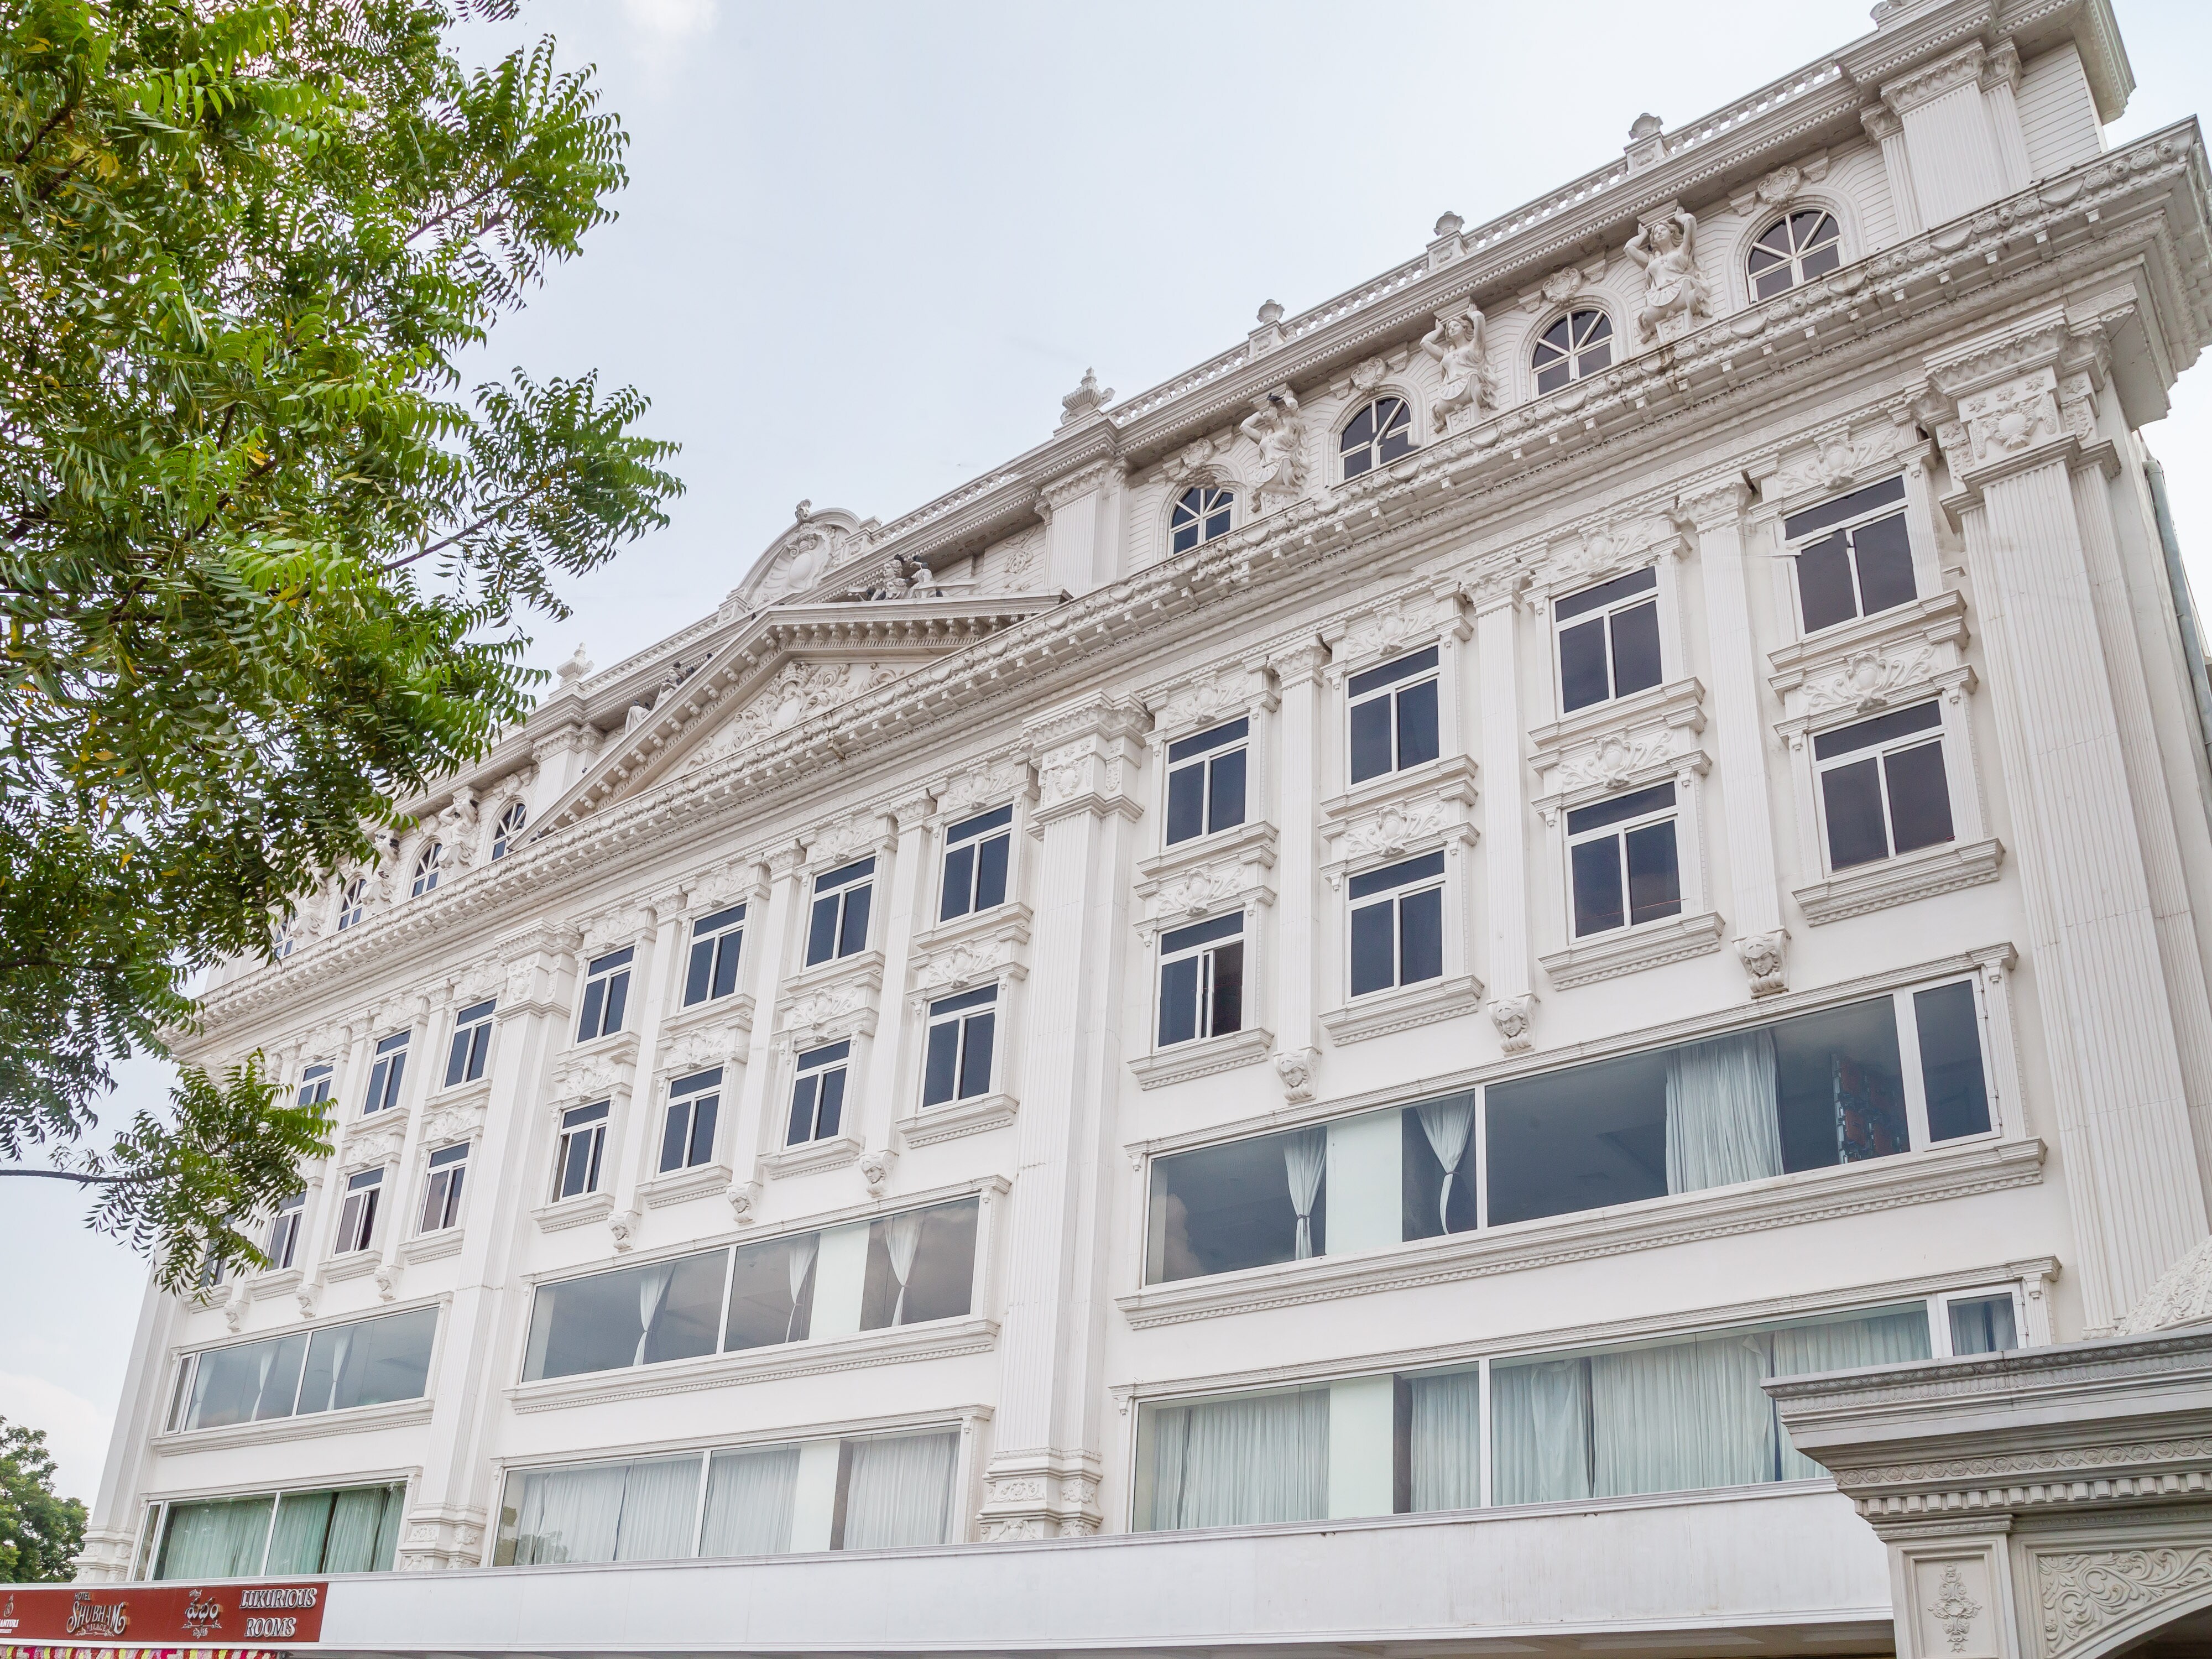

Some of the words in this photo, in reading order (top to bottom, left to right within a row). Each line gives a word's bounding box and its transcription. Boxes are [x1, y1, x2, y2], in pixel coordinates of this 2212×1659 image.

[74, 1592, 91, 1600] HOTEL
[239, 1588, 317, 1609] LUXURIOUS
[0, 1619, 19, 1627] ANTURI
[66, 1600, 126, 1634] SHUBHAM
[86, 1623, 107, 1632] PALACE
[244, 1616, 296, 1637] ROOMS
